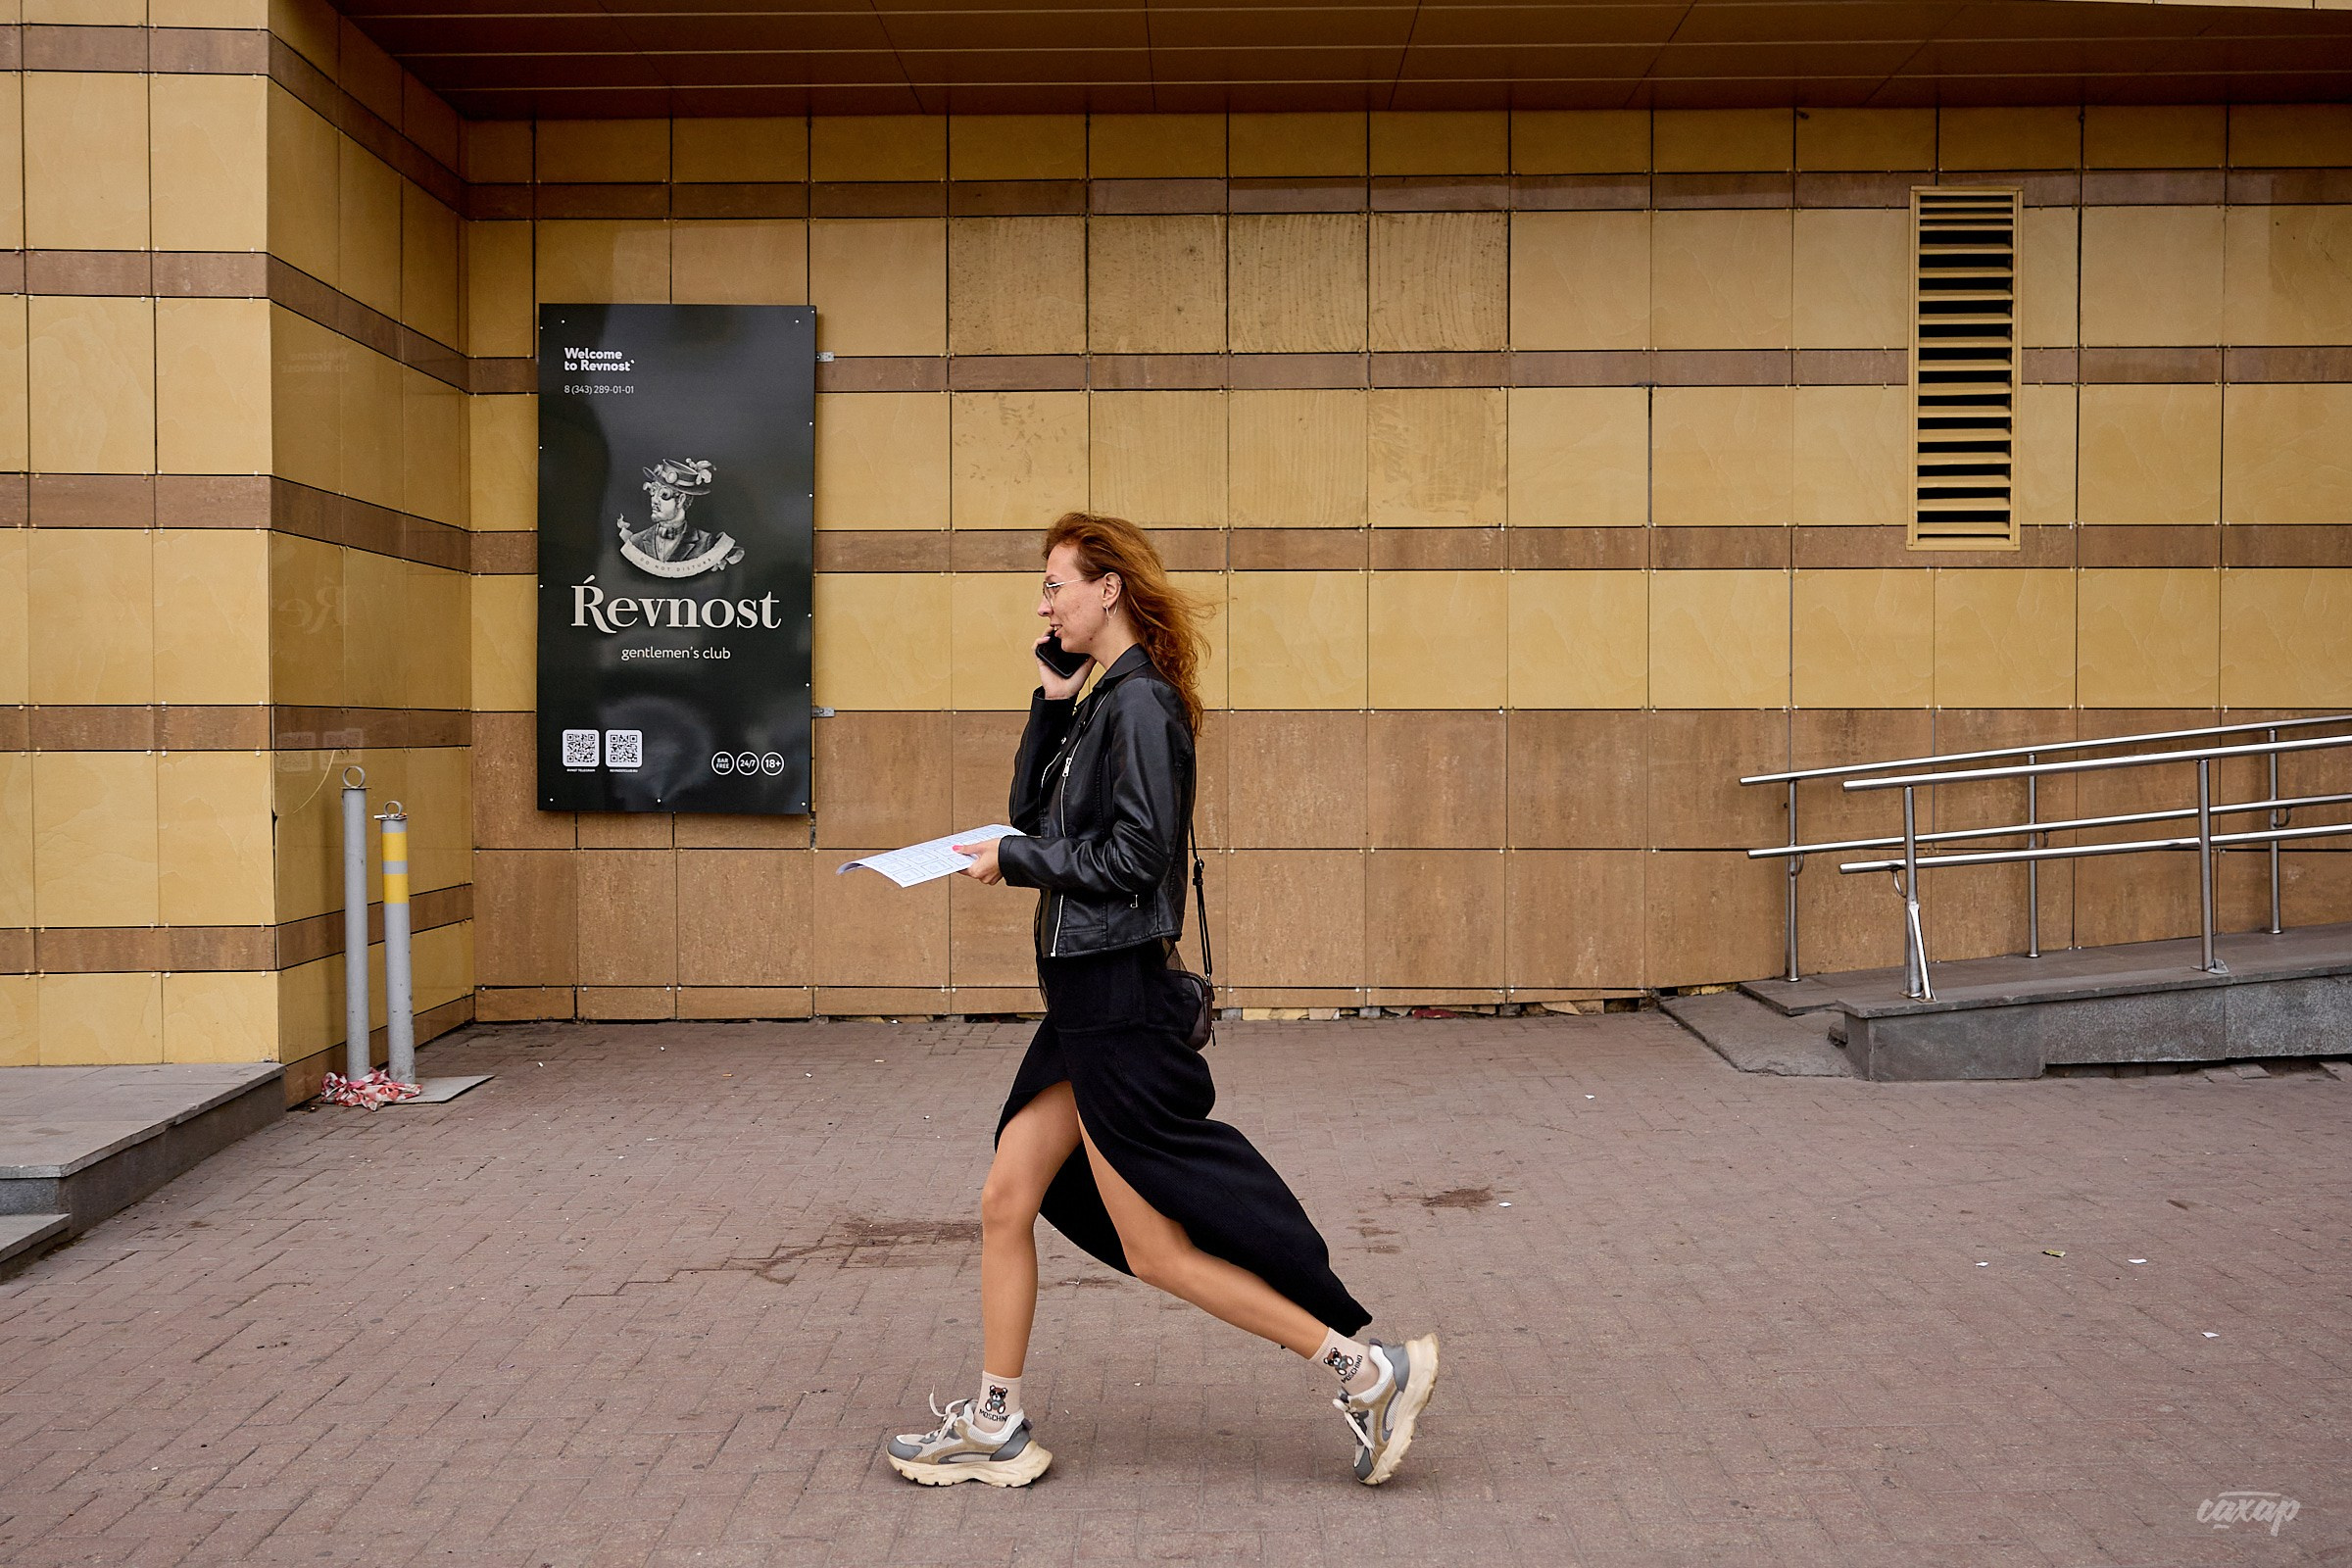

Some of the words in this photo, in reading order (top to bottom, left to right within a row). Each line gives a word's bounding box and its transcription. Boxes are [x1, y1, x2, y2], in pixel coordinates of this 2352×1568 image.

[564, 347, 623, 360] Welcome
[564, 361, 578, 371] to
[564, 384, 570, 394] 8
[571, 384, 593, 395] (343)
[593, 384, 635, 394] 289-01-01
[702, 647, 731, 660] club
[740, 759, 757, 768] 24/7
[764, 759, 782, 768] 18+
[1340, 1354, 1363, 1384] MOSCHINO
